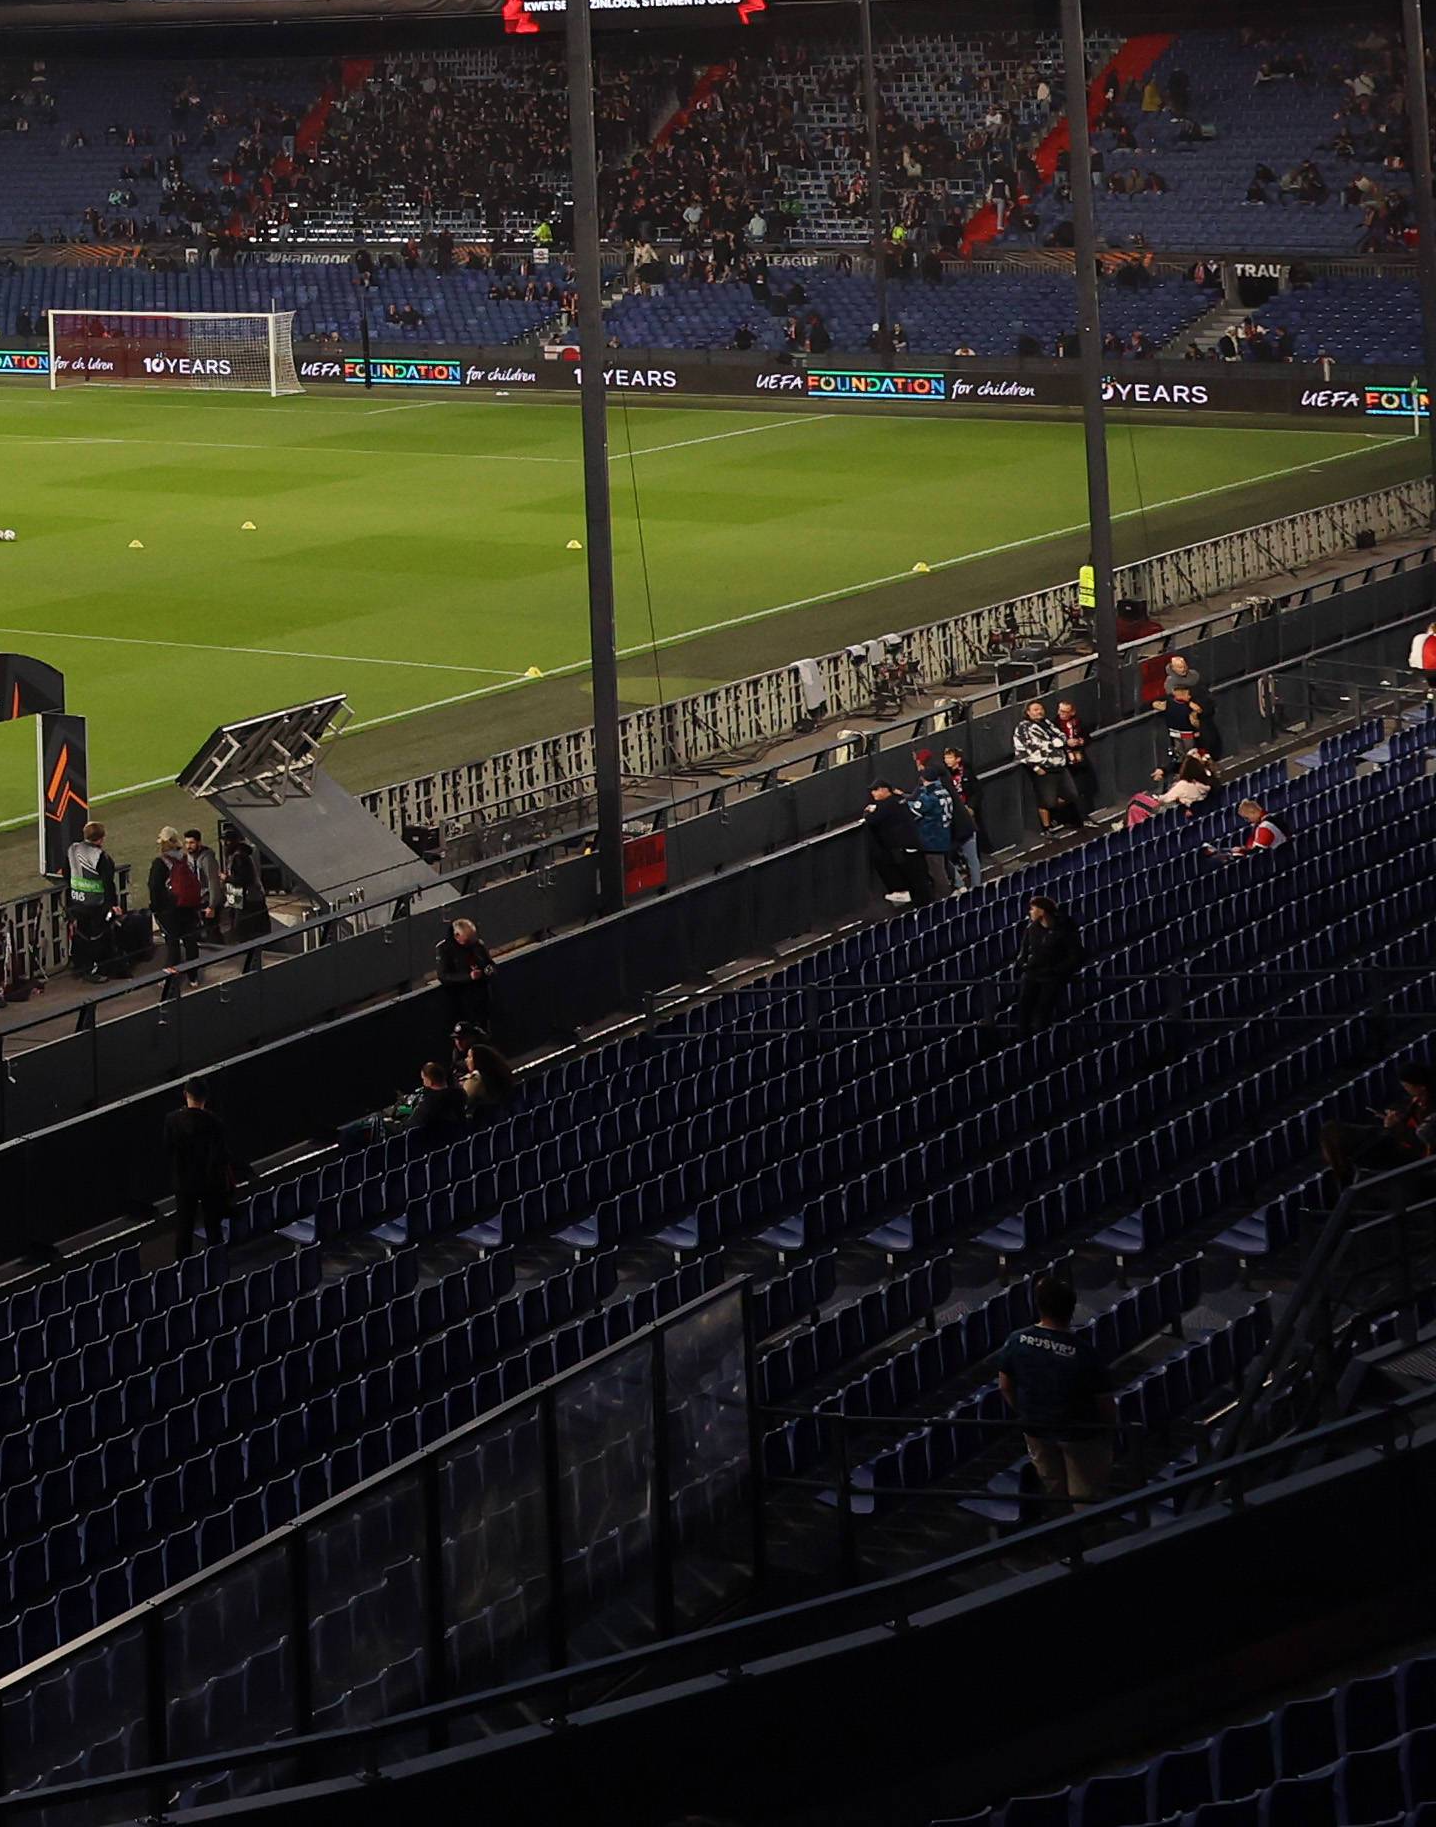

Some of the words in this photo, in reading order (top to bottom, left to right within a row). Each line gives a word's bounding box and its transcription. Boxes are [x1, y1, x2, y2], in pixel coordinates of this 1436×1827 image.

[524, 0, 567, 12] KWETSE
[53, 356, 68, 373] for
[300, 362, 342, 377] UEFA
[465, 366, 485, 385] for
[487, 366, 537, 383] children
[756, 373, 804, 390] UEFA
[951, 378, 974, 400] for
[976, 379, 1037, 398] children
[1300, 389, 1361, 408] UEFA
